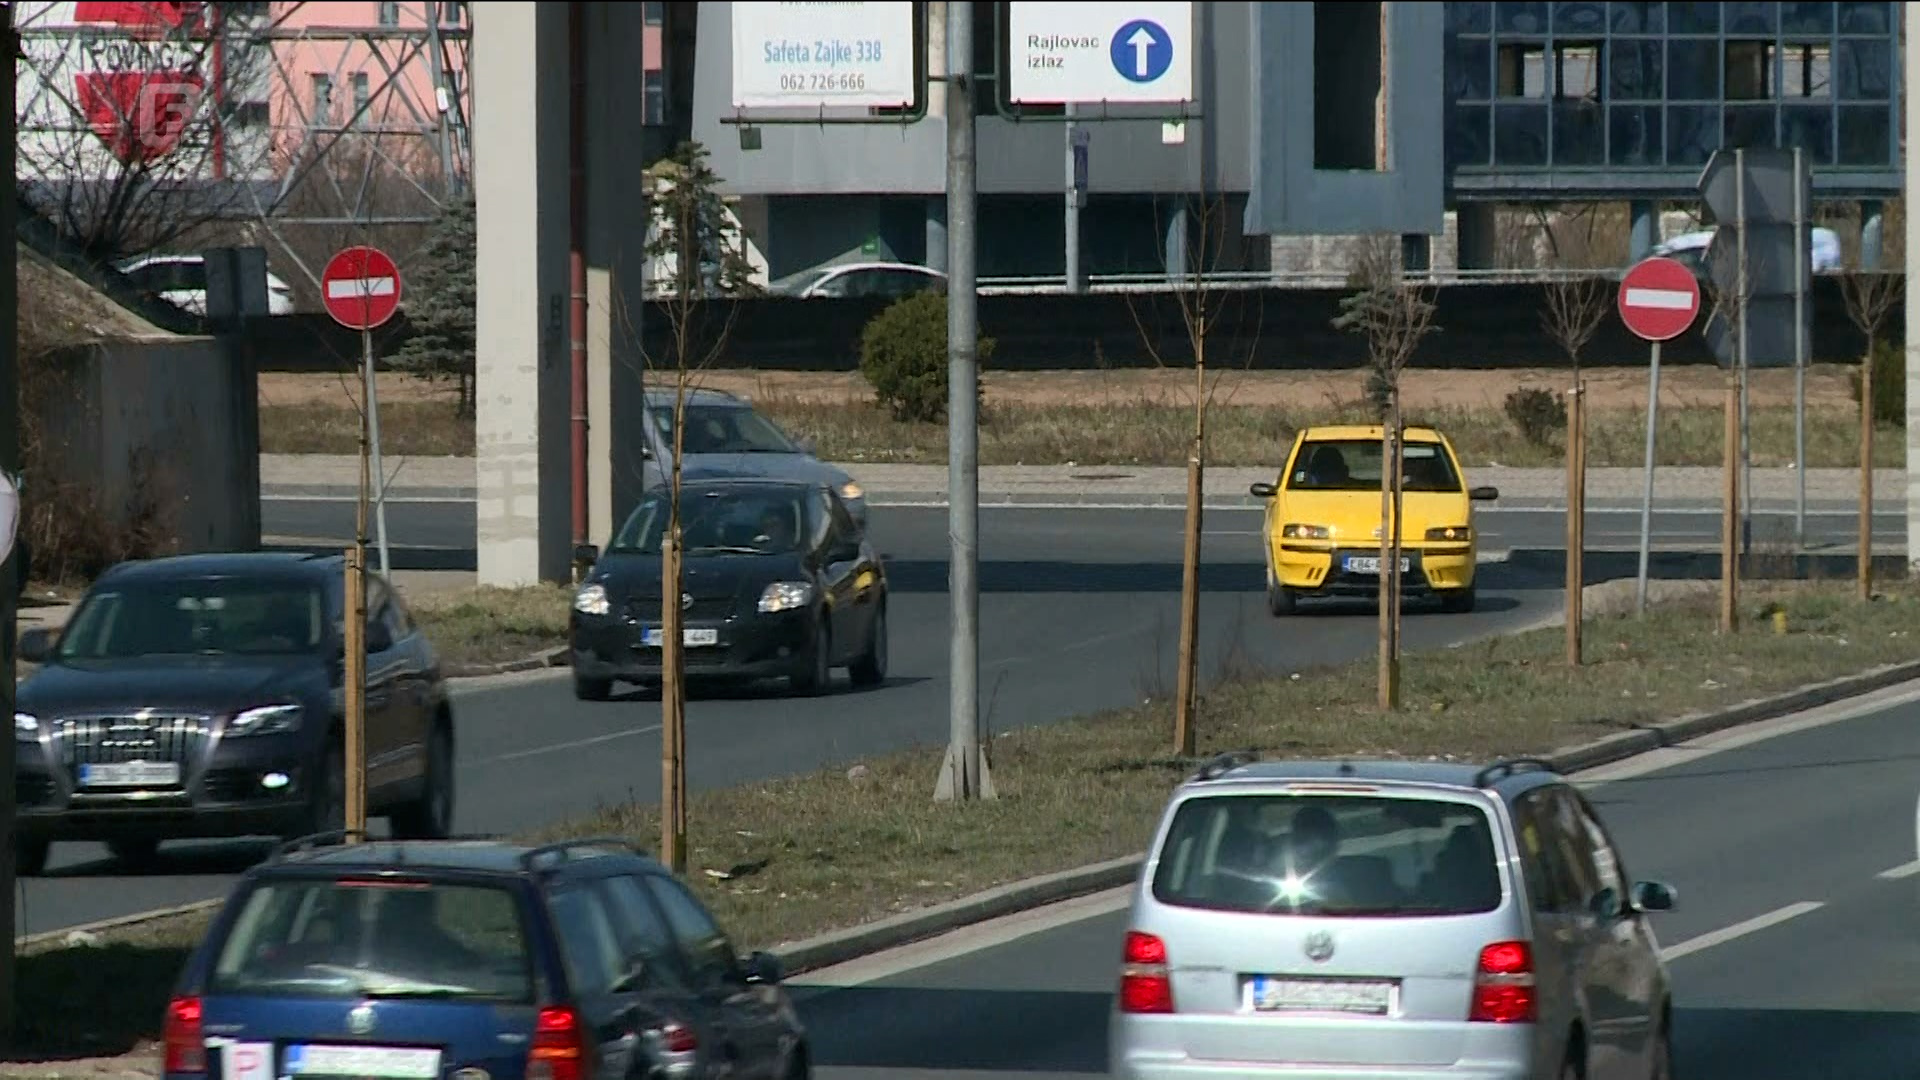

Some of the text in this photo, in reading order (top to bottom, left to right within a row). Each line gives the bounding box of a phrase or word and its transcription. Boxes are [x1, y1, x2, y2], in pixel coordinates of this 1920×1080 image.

[1027, 35, 1099, 52] Rajlovac
[764, 40, 882, 67] Safeta Zajke 338
[1027, 53, 1064, 68] izlaz
[780, 73, 865, 90] 062 726-666
